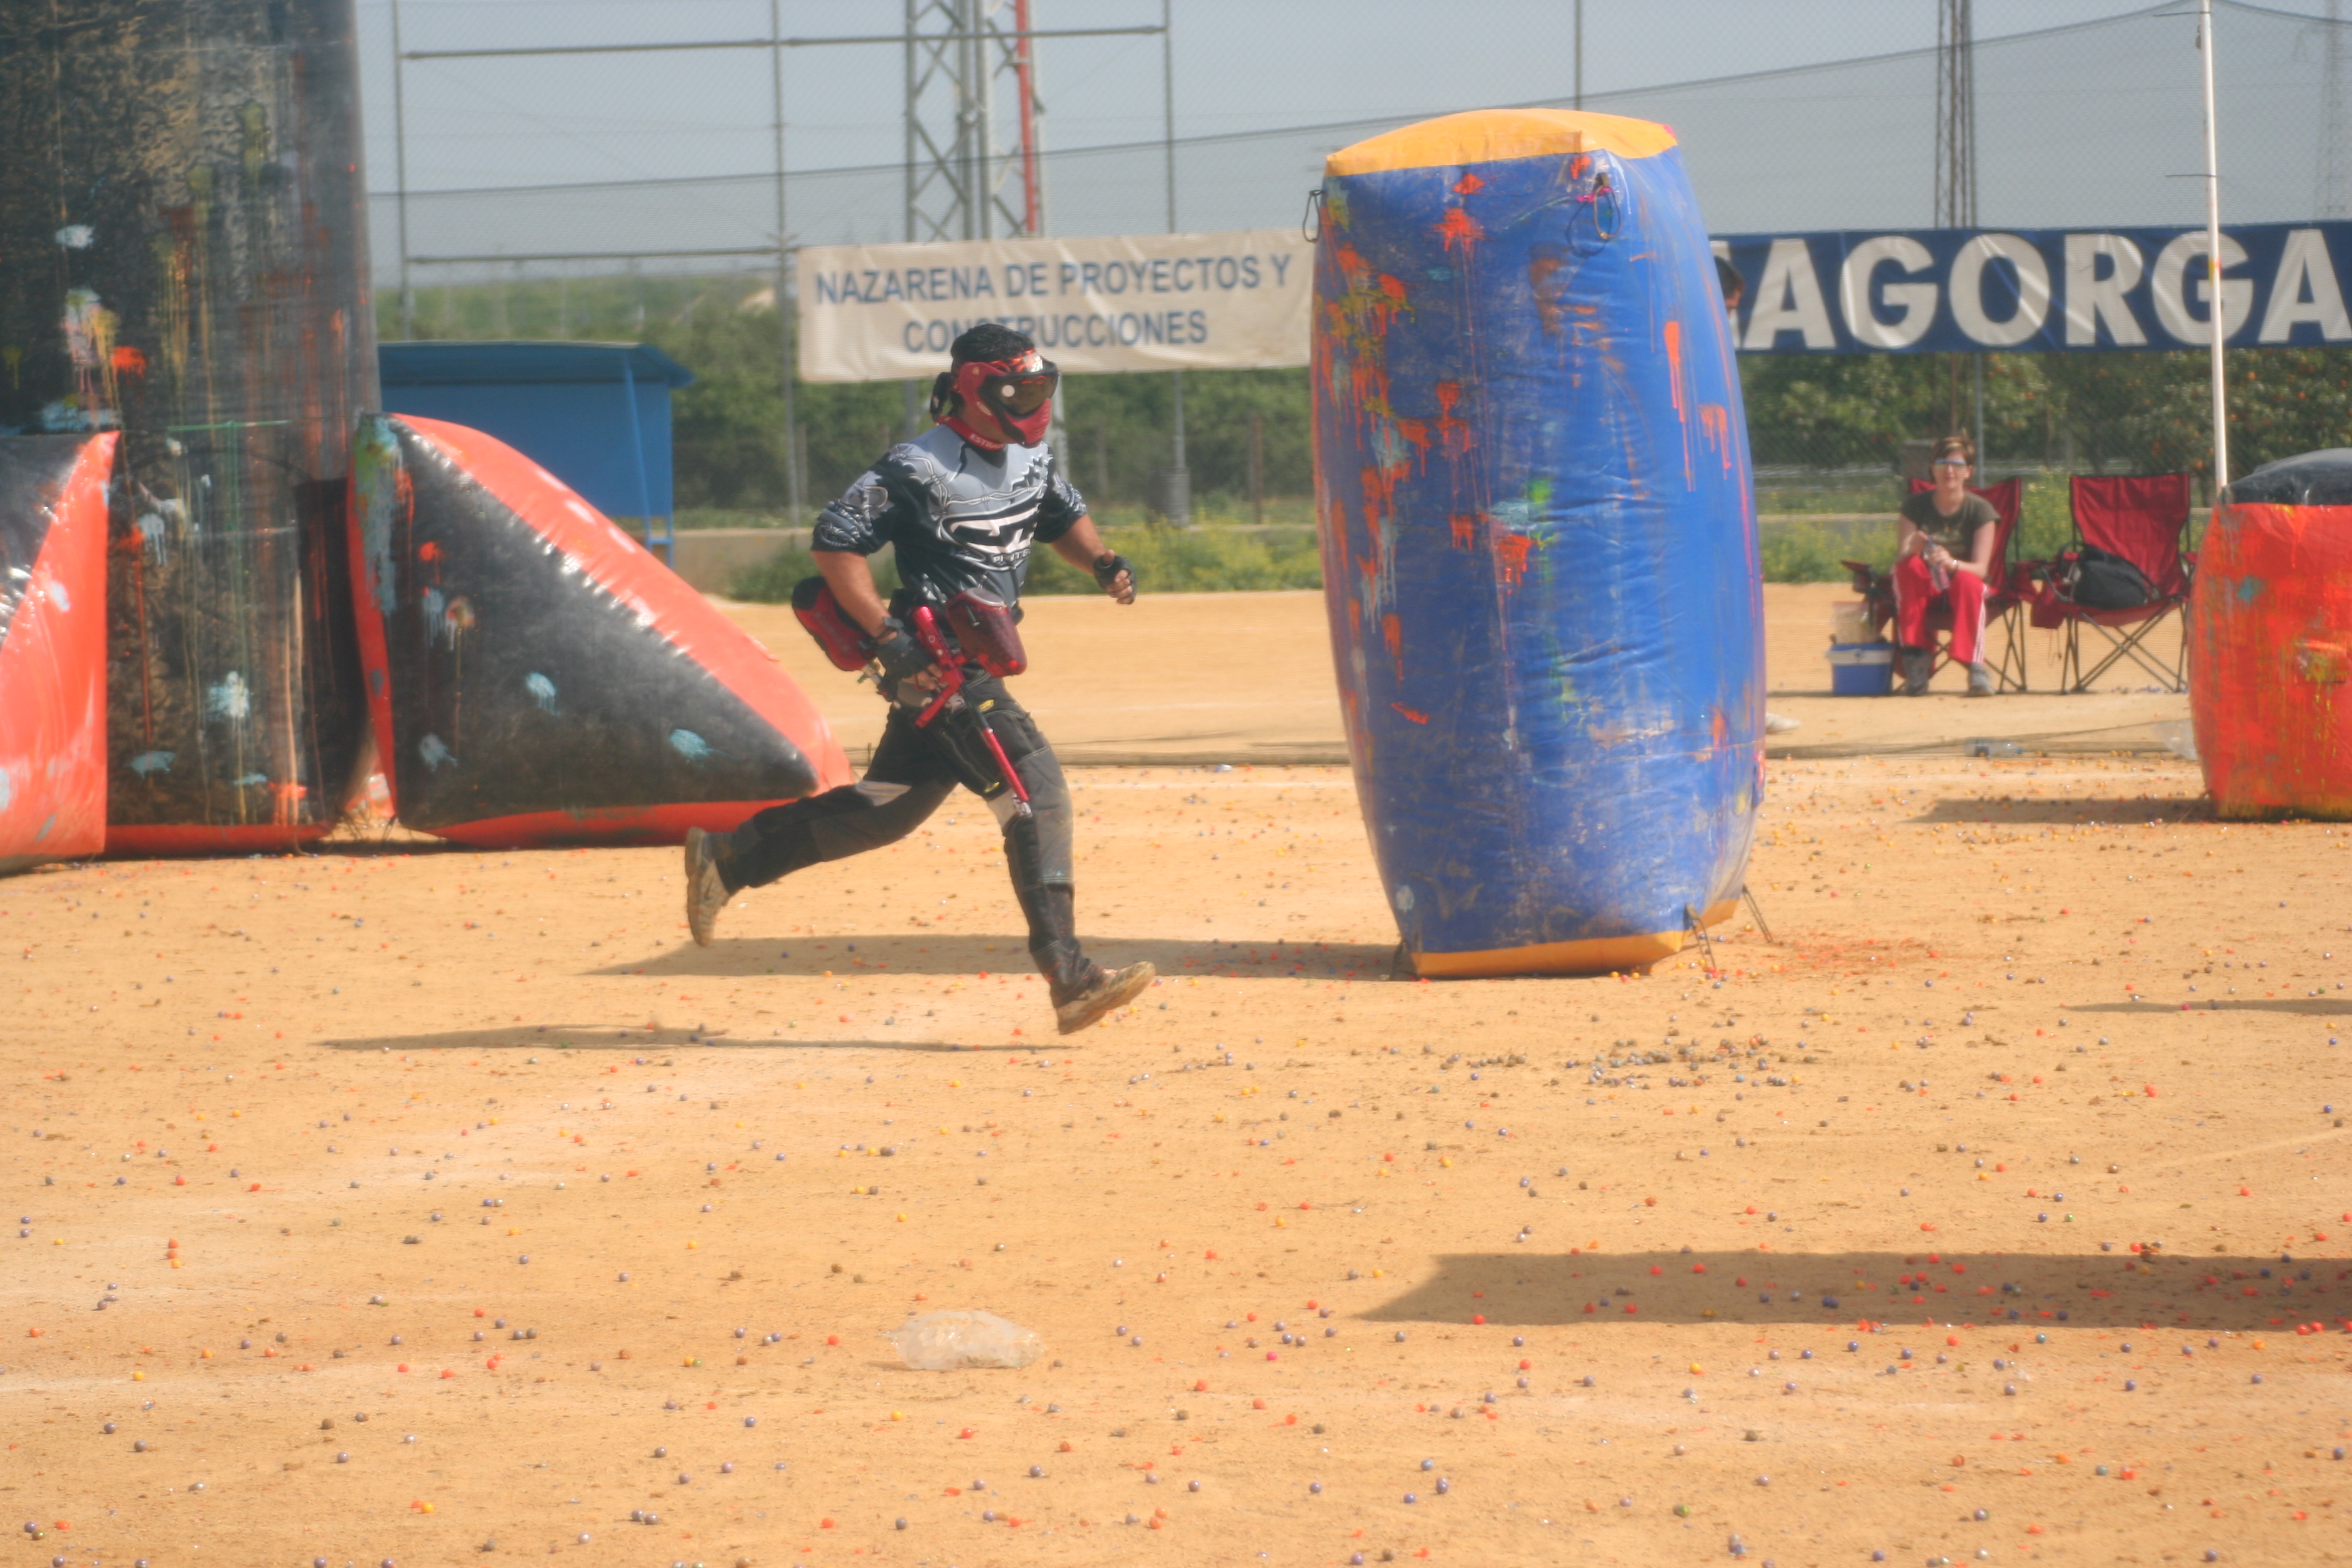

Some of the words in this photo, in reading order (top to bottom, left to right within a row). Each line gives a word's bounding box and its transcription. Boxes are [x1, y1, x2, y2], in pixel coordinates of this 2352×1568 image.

[817, 265, 995, 304] NAZARENA
[1006, 262, 1048, 297] DE
[1058, 255, 1261, 295] PROYECTOS
[1270, 253, 1291, 287] Y
[1710, 227, 2352, 349] AGORGA
[904, 310, 1207, 353] CORUCCIONES
